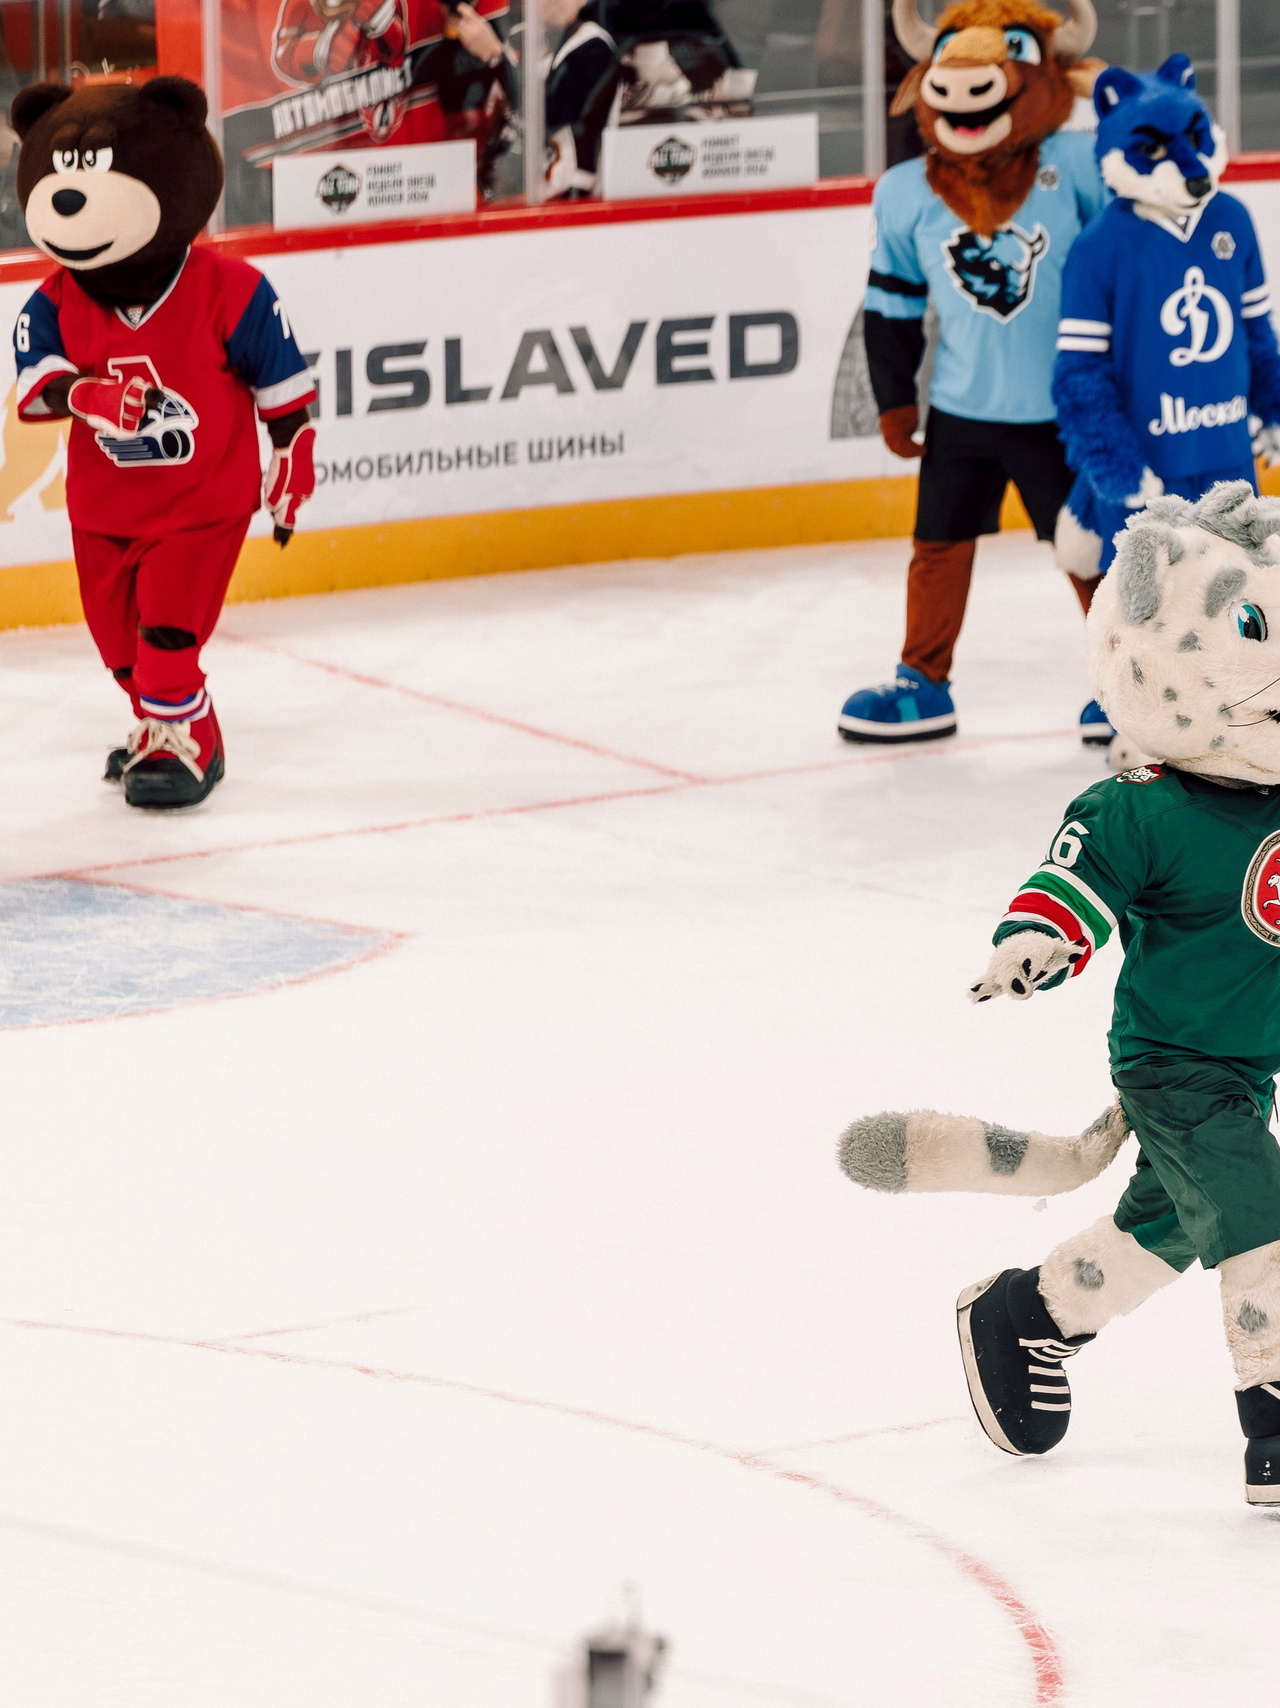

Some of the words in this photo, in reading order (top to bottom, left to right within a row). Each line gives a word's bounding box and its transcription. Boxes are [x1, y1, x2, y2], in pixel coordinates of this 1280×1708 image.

[302, 310, 799, 419] ISLAVED
[314, 440, 518, 486] ОМОБИЛЬНЫЕ
[527, 430, 626, 465] ШИНЫ
[1045, 820, 1091, 868] 6
